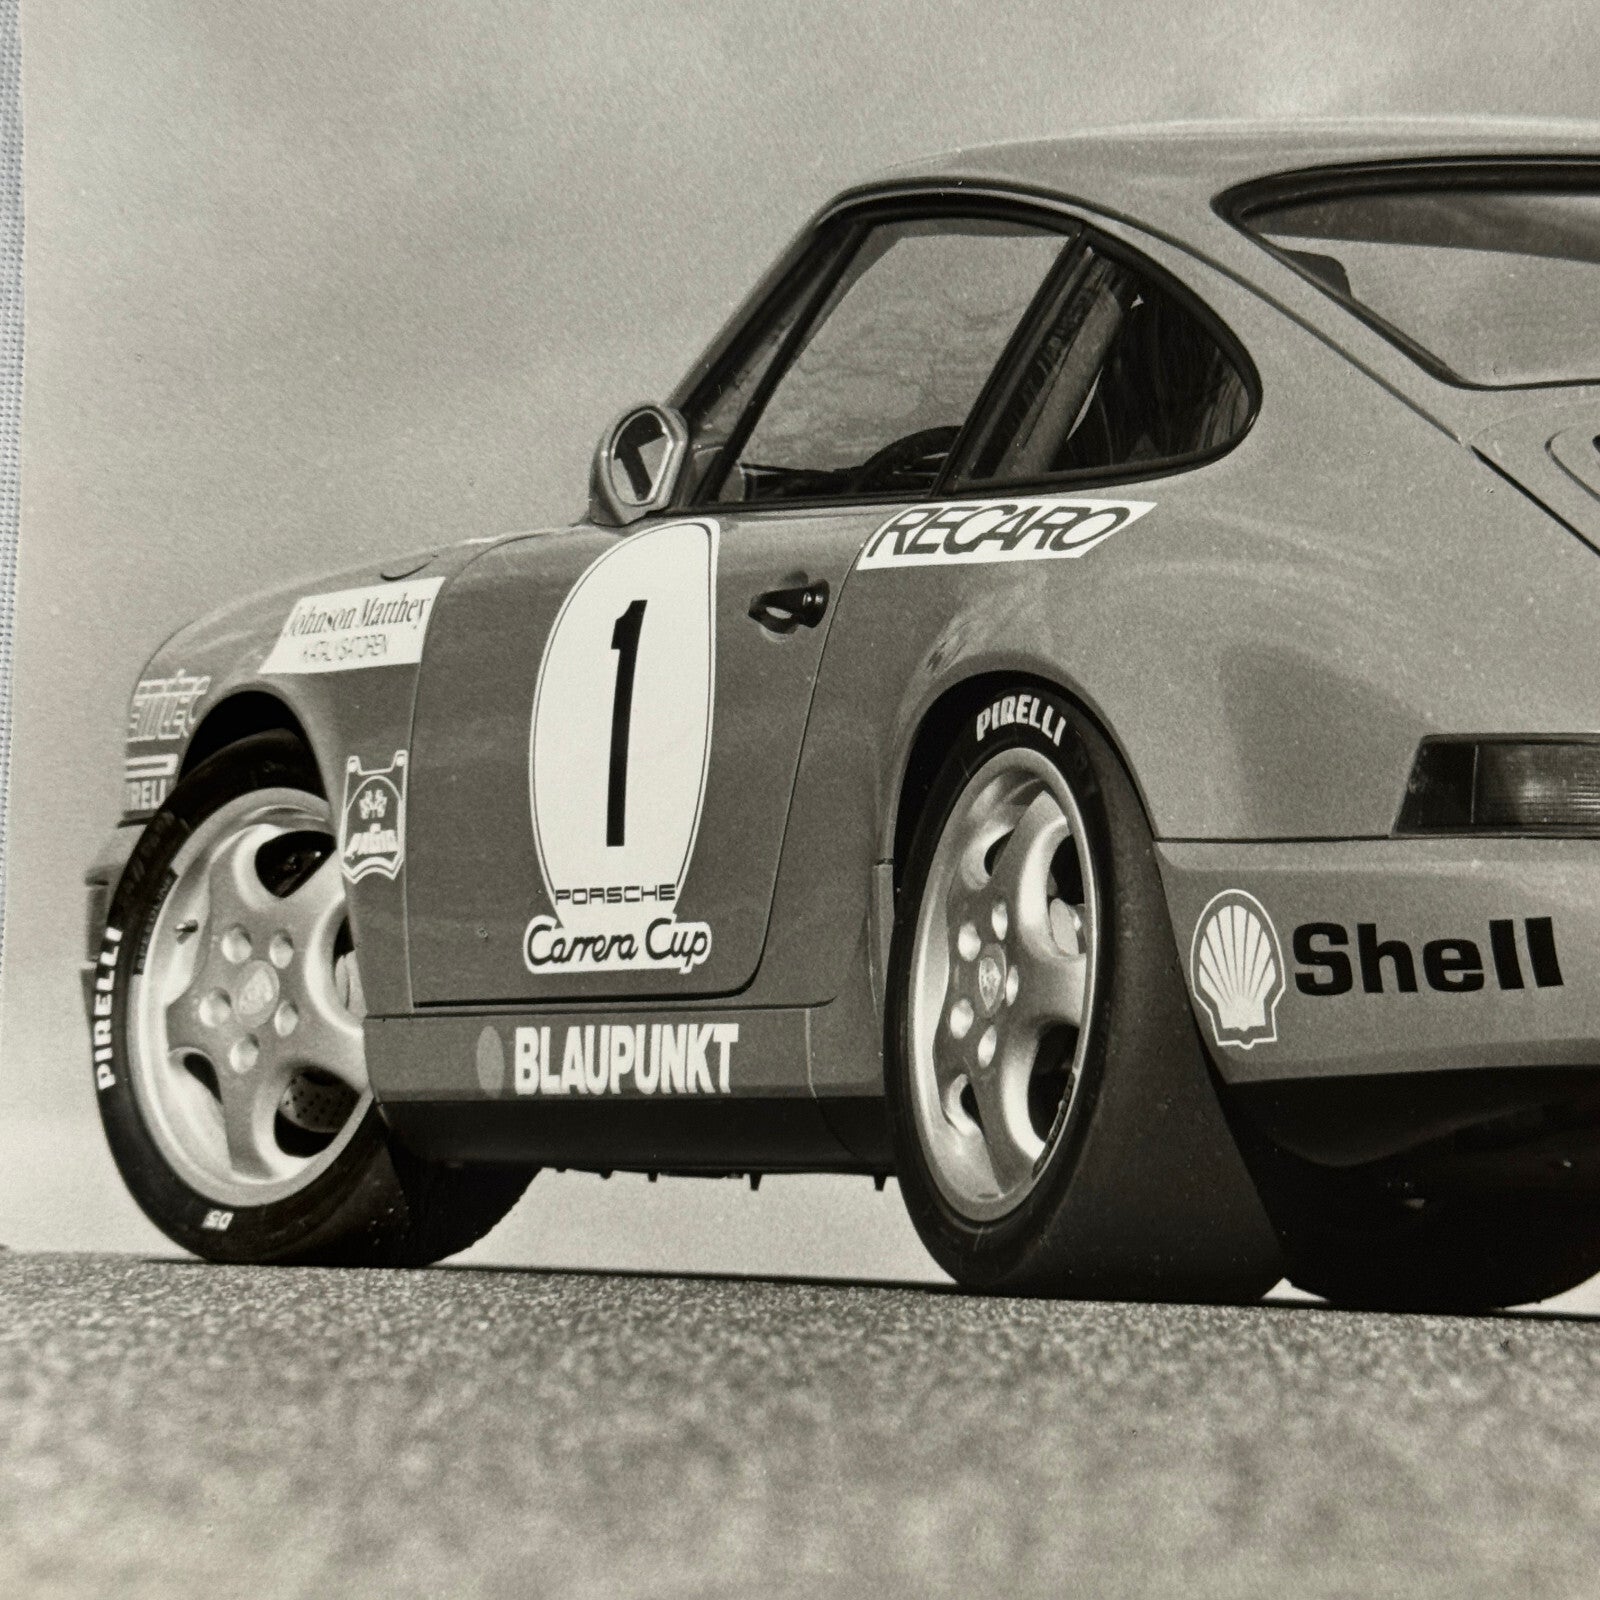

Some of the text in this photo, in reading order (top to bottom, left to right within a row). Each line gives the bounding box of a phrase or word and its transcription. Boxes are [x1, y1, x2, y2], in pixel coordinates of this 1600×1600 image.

[866, 504, 1131, 558] RECARO
[357, 593, 431, 630] Matthey
[606, 599, 648, 847] 1
[976, 694, 1066, 747] PIRELLI
[555, 884, 676, 905] PORSCHE
[527, 917, 708, 967] Carrera Cup
[1292, 916, 1564, 997] Shell
[94, 926, 123, 1090] PIRELLI
[514, 1023, 739, 1095] BLAUPUNKT
